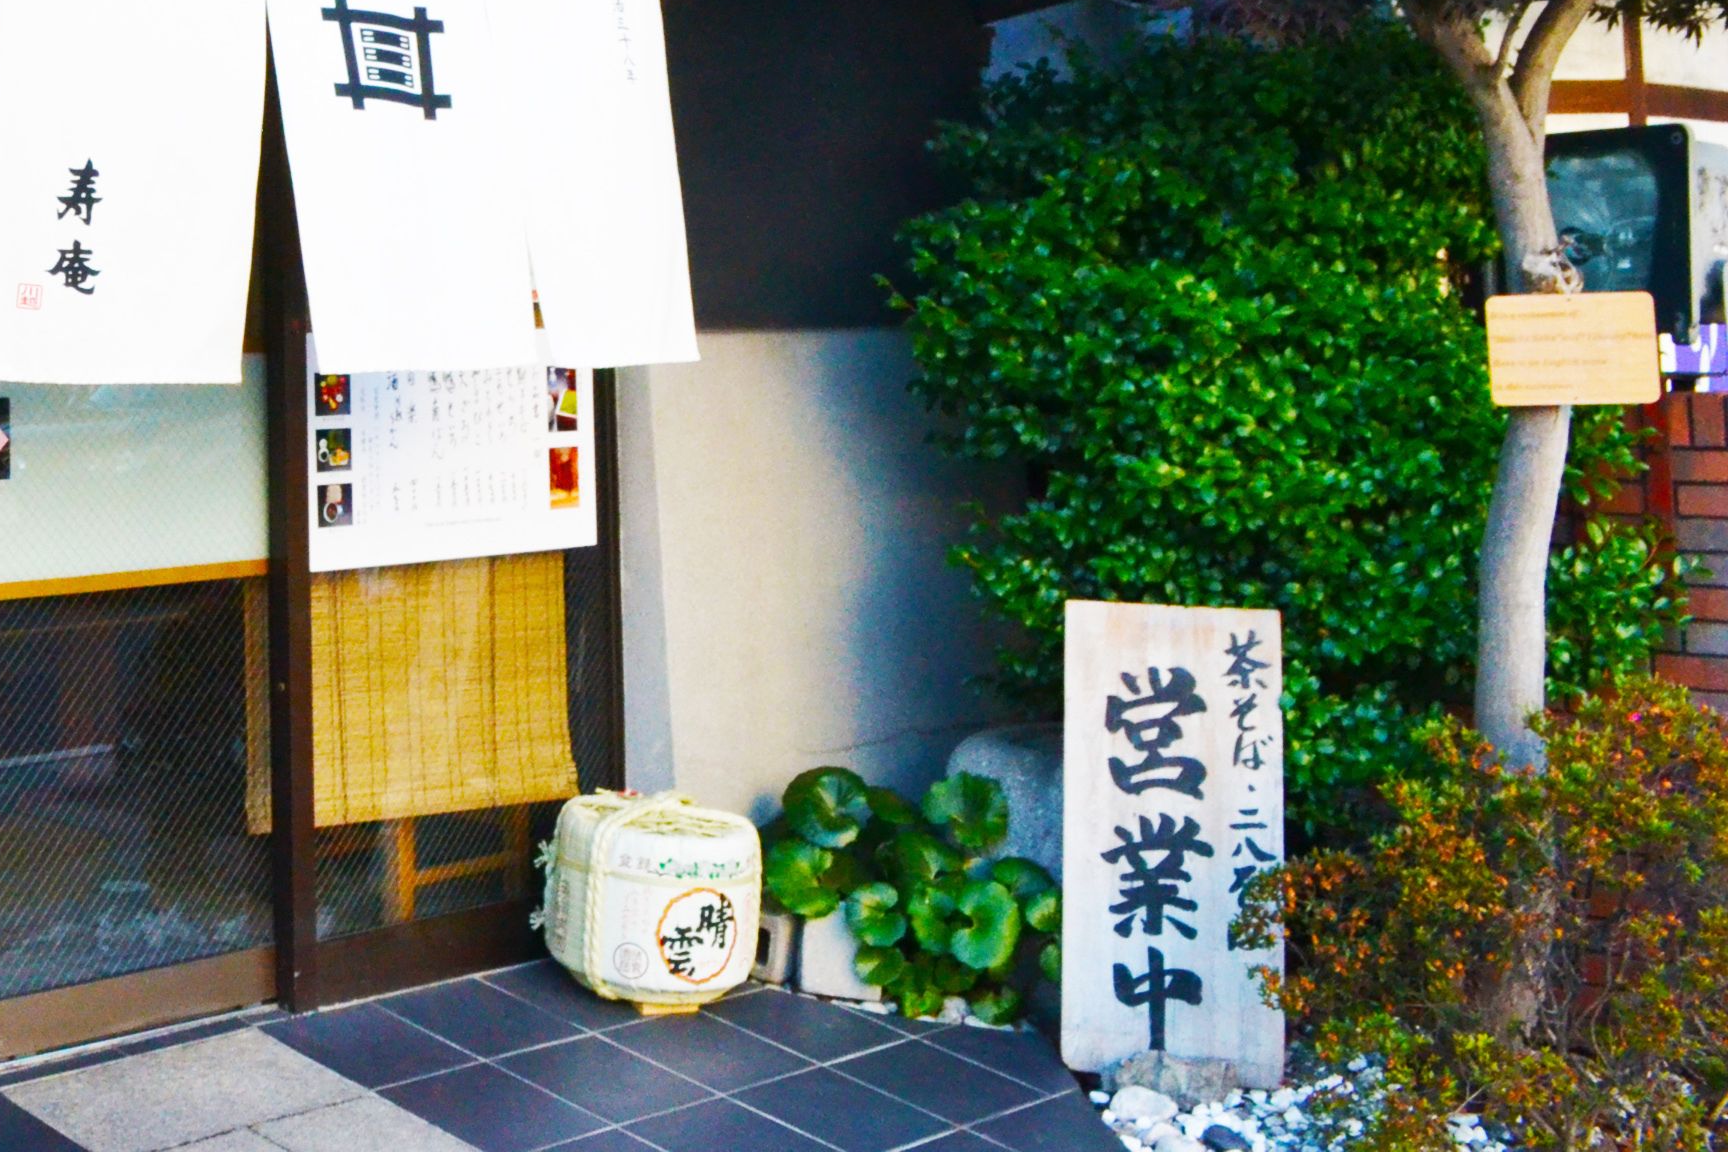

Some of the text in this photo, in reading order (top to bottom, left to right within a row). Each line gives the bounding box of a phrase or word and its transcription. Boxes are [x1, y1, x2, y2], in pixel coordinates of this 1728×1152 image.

[46, 159, 103, 295] 寿庵
[1101, 667, 1215, 1052] 営業中
